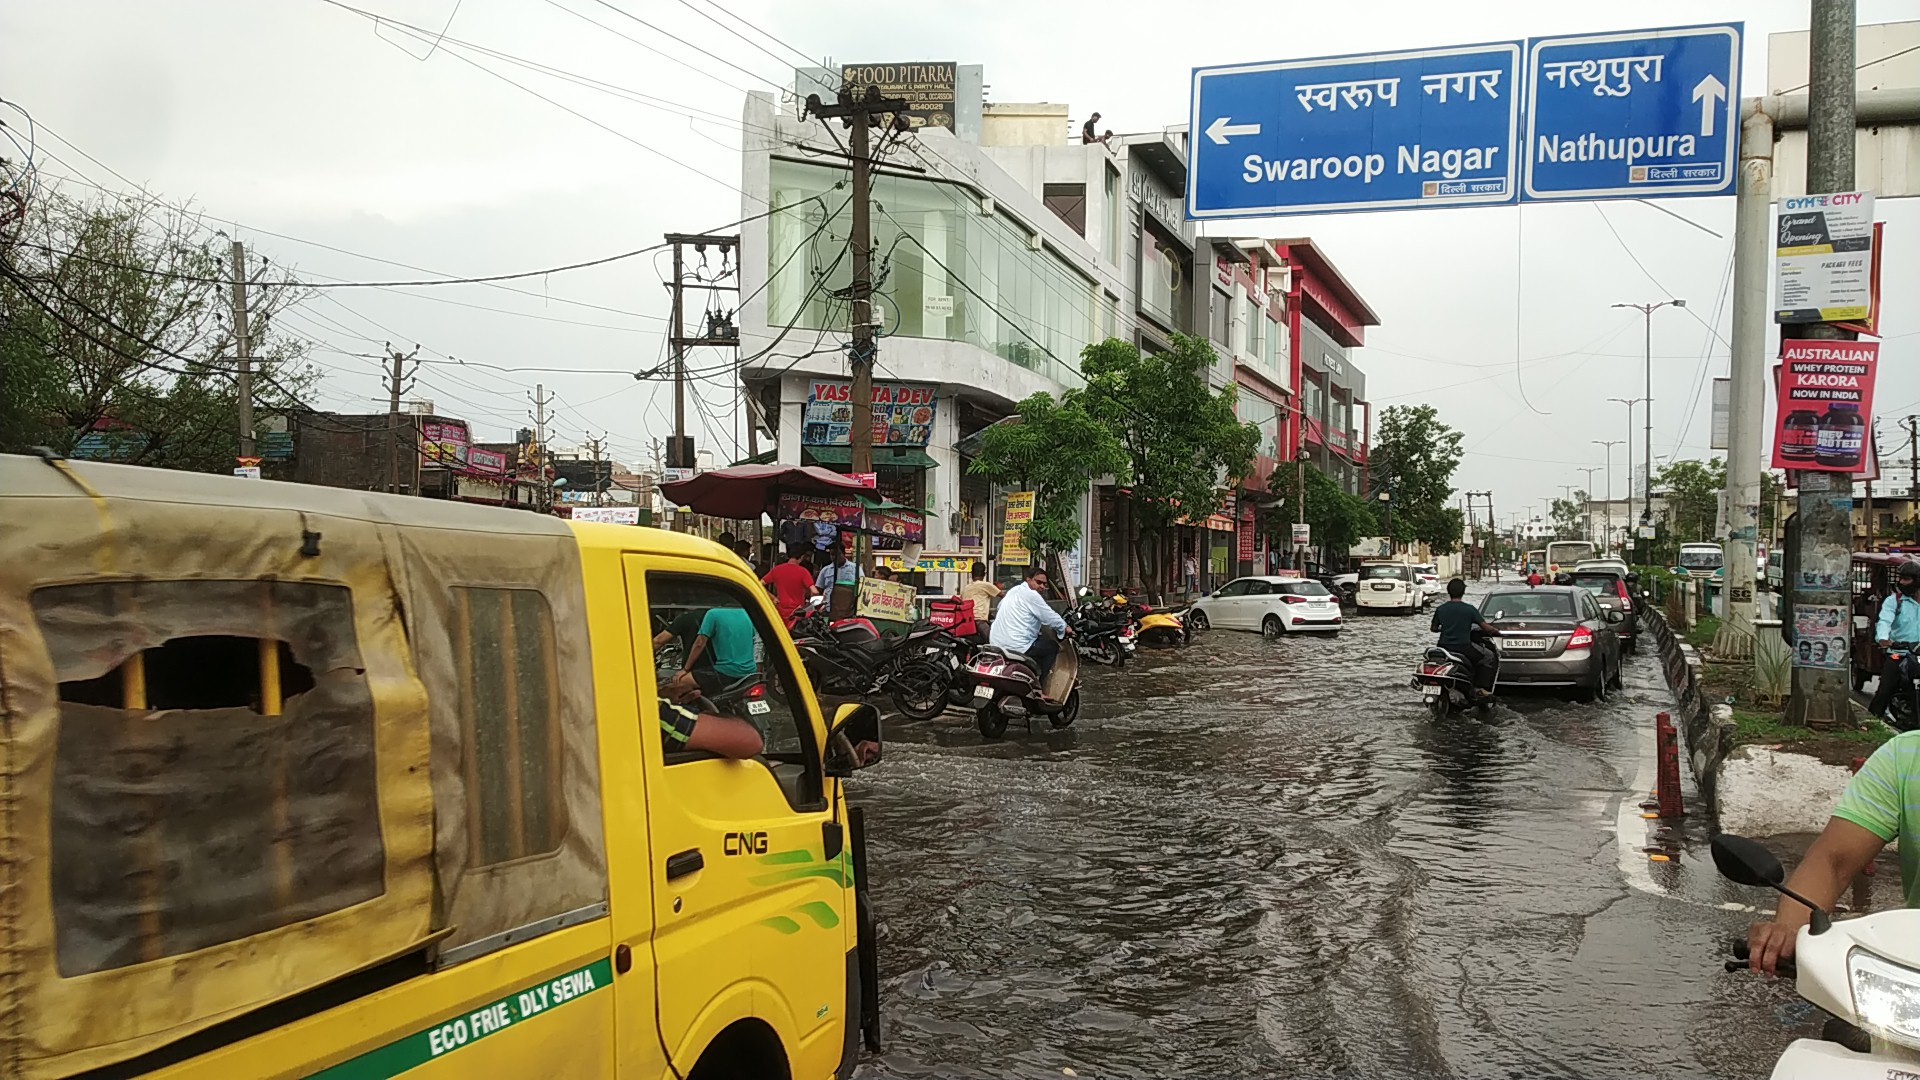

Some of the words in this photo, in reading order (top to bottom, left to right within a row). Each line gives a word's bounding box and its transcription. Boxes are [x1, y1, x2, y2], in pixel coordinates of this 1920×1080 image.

[856, 66, 896, 84] FOOD
[900, 65, 954, 83] PITARRA
[1543, 55, 1665, 97] नत्थूपुरा
[1294, 77, 1401, 113] स्वरूप
[1420, 69, 1503, 103] नगर
[1537, 132, 1696, 165] Nathupura
[1242, 153, 1385, 184] Swaroop
[1397, 144, 1499, 179] Nagar
[1650, 169, 1678, 180] दिल्ली
[1683, 168, 1717, 178] सरकार
[1440, 183, 1466, 195] दिल्ली
[1470, 182, 1502, 193] सरकार
[1786, 196, 1816, 210] GYM
[1832, 193, 1863, 206] CITY
[1781, 215, 1817, 233] Grand
[1781, 231, 1824, 245] Opening
[1785, 348, 1875, 362] AUSTRALIAN
[1794, 364, 1823, 372] WHEY
[1824, 364, 1865, 374] PROTEIN
[1797, 374, 1859, 387] KARORA
[814, 383, 893, 404] YASTA
[897, 387, 935, 404] DEV
[1793, 390, 1819, 398] NOW
[1820, 390, 1830, 399] IN
[1832, 391, 1859, 400] INDIA
[723, 831, 769, 857] CNG
[428, 1019, 468, 1057] ECO
[551, 969, 596, 1004] SEWA
